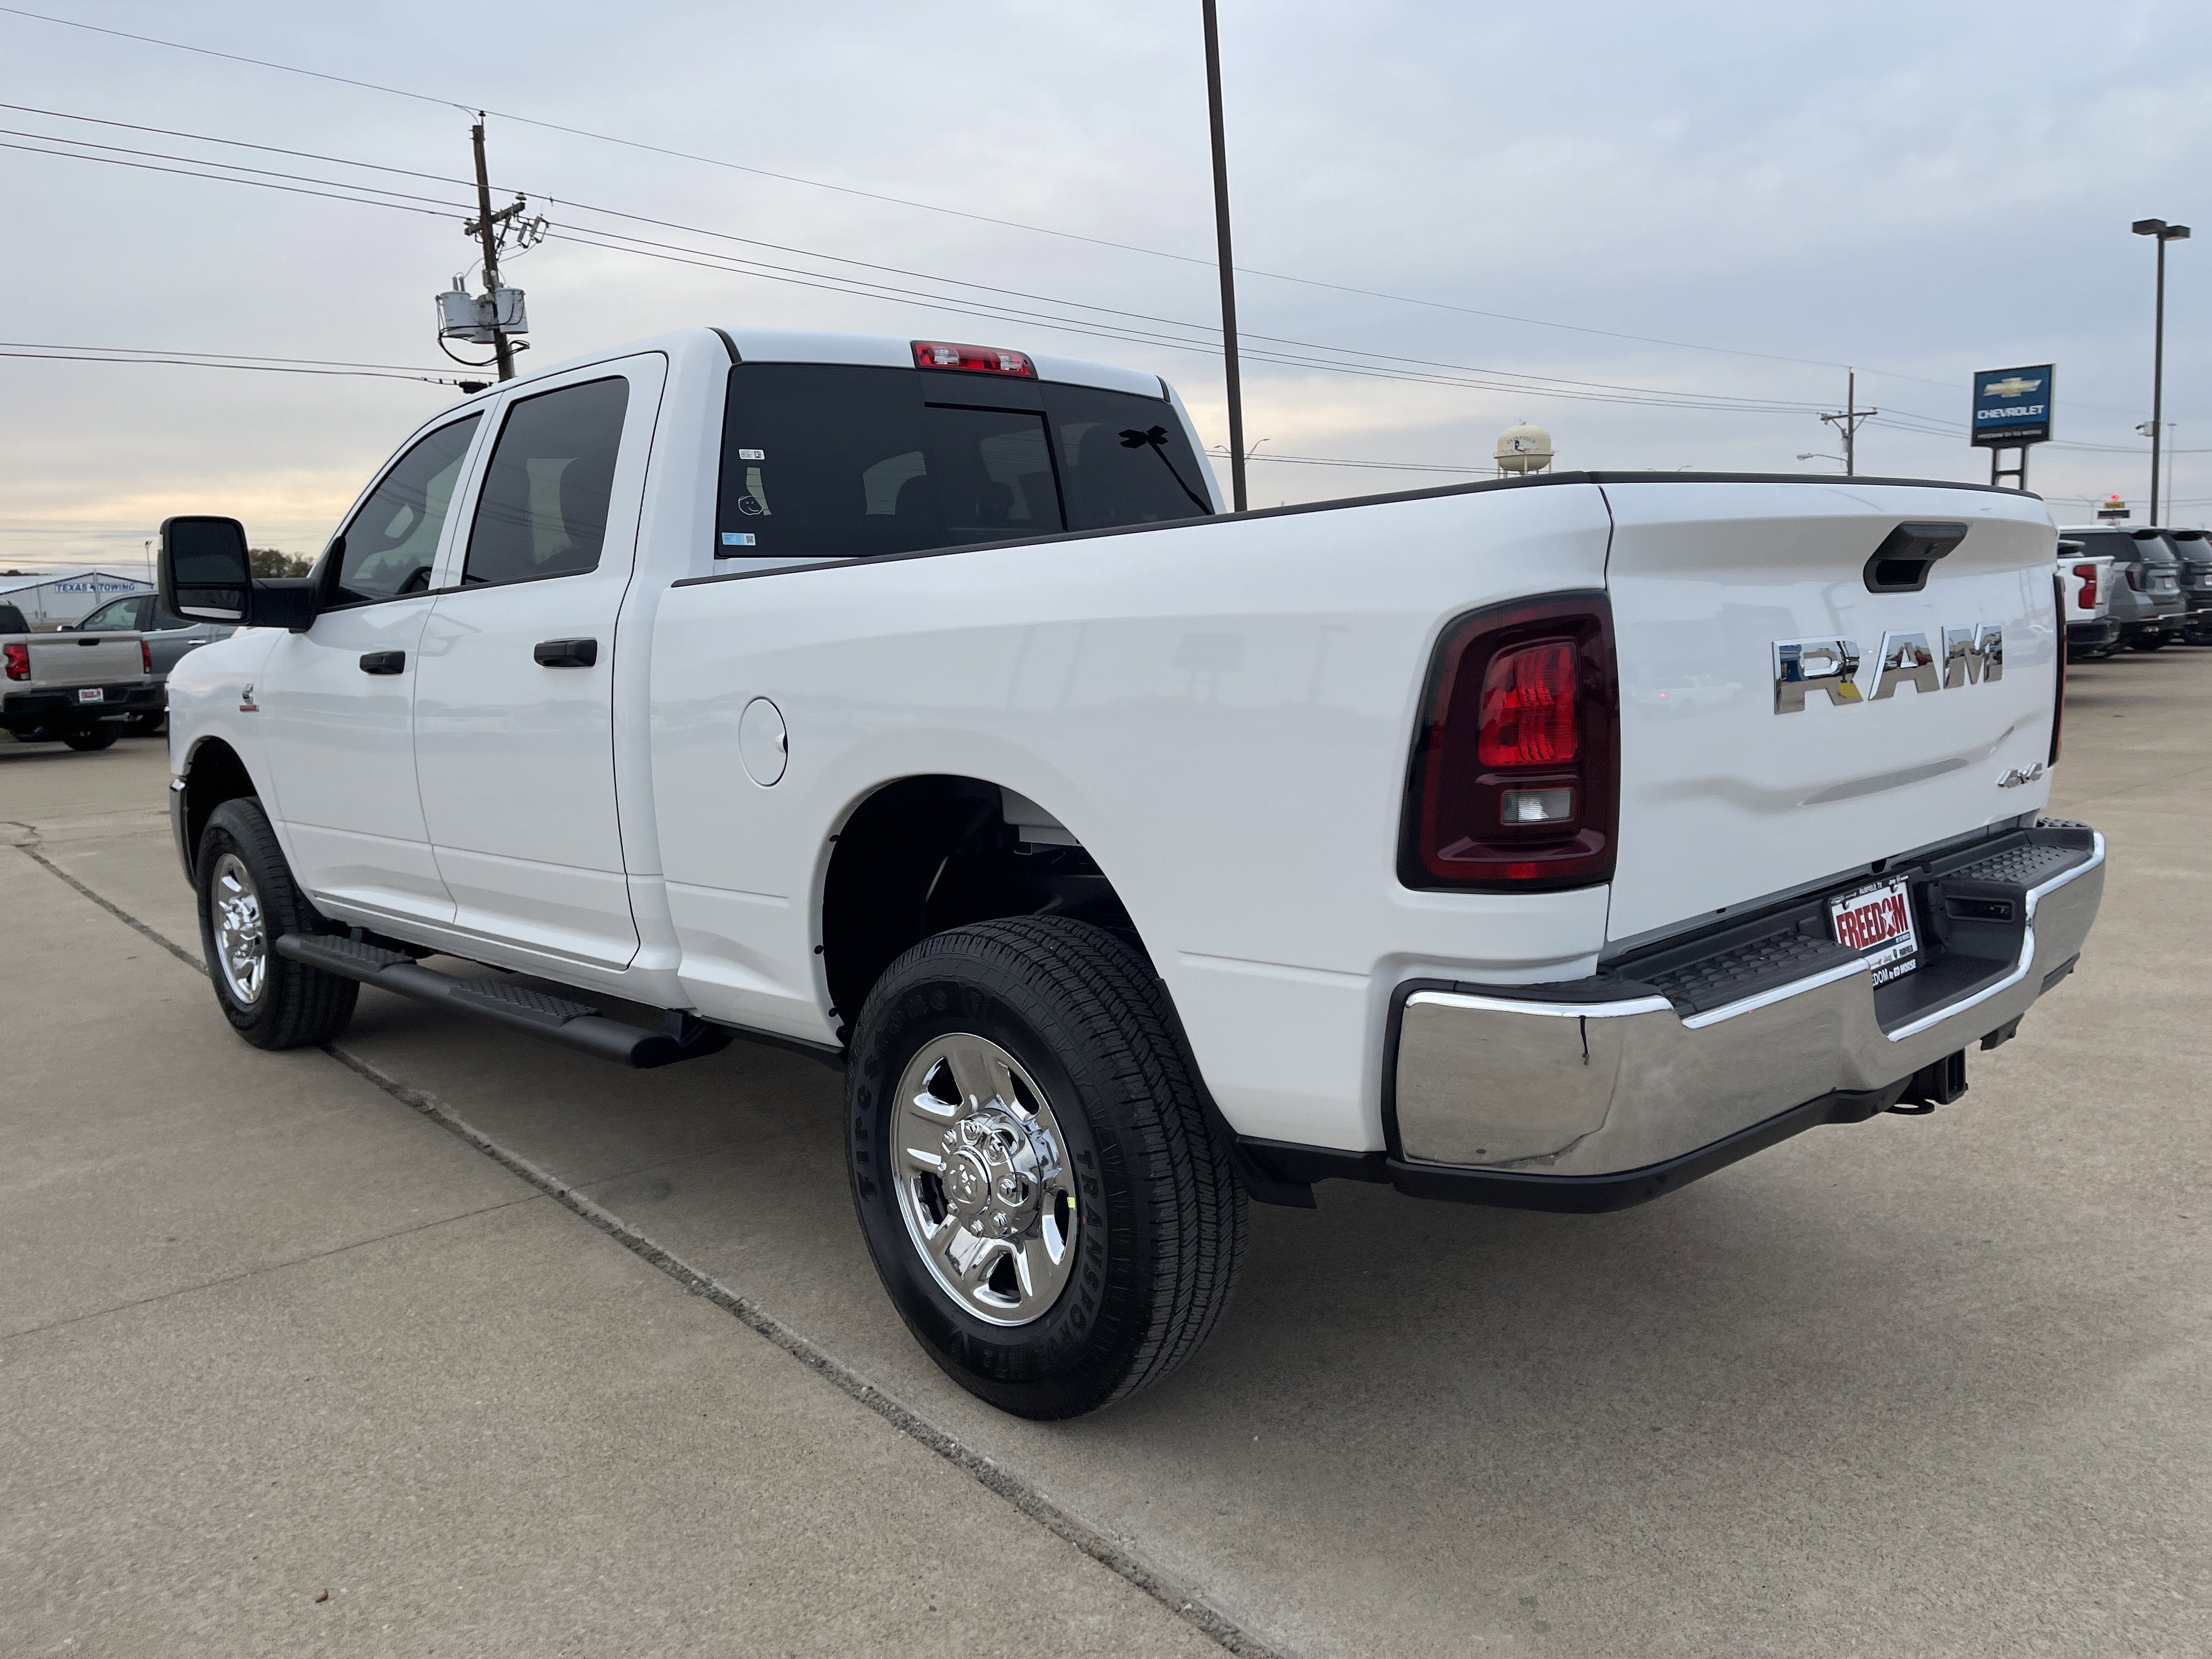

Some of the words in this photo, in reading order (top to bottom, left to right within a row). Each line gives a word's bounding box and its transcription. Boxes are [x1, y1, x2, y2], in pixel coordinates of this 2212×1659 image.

[1977, 404, 2045, 420] CHEVROLET
[57, 583, 87, 592] TEXAS
[99, 583, 135, 592] TOWING
[1772, 622, 2002, 714] RAM
[1836, 893, 1909, 950] FREEDOM
[1894, 967, 1900, 977] ED
[1900, 959, 1916, 974] MORSE
